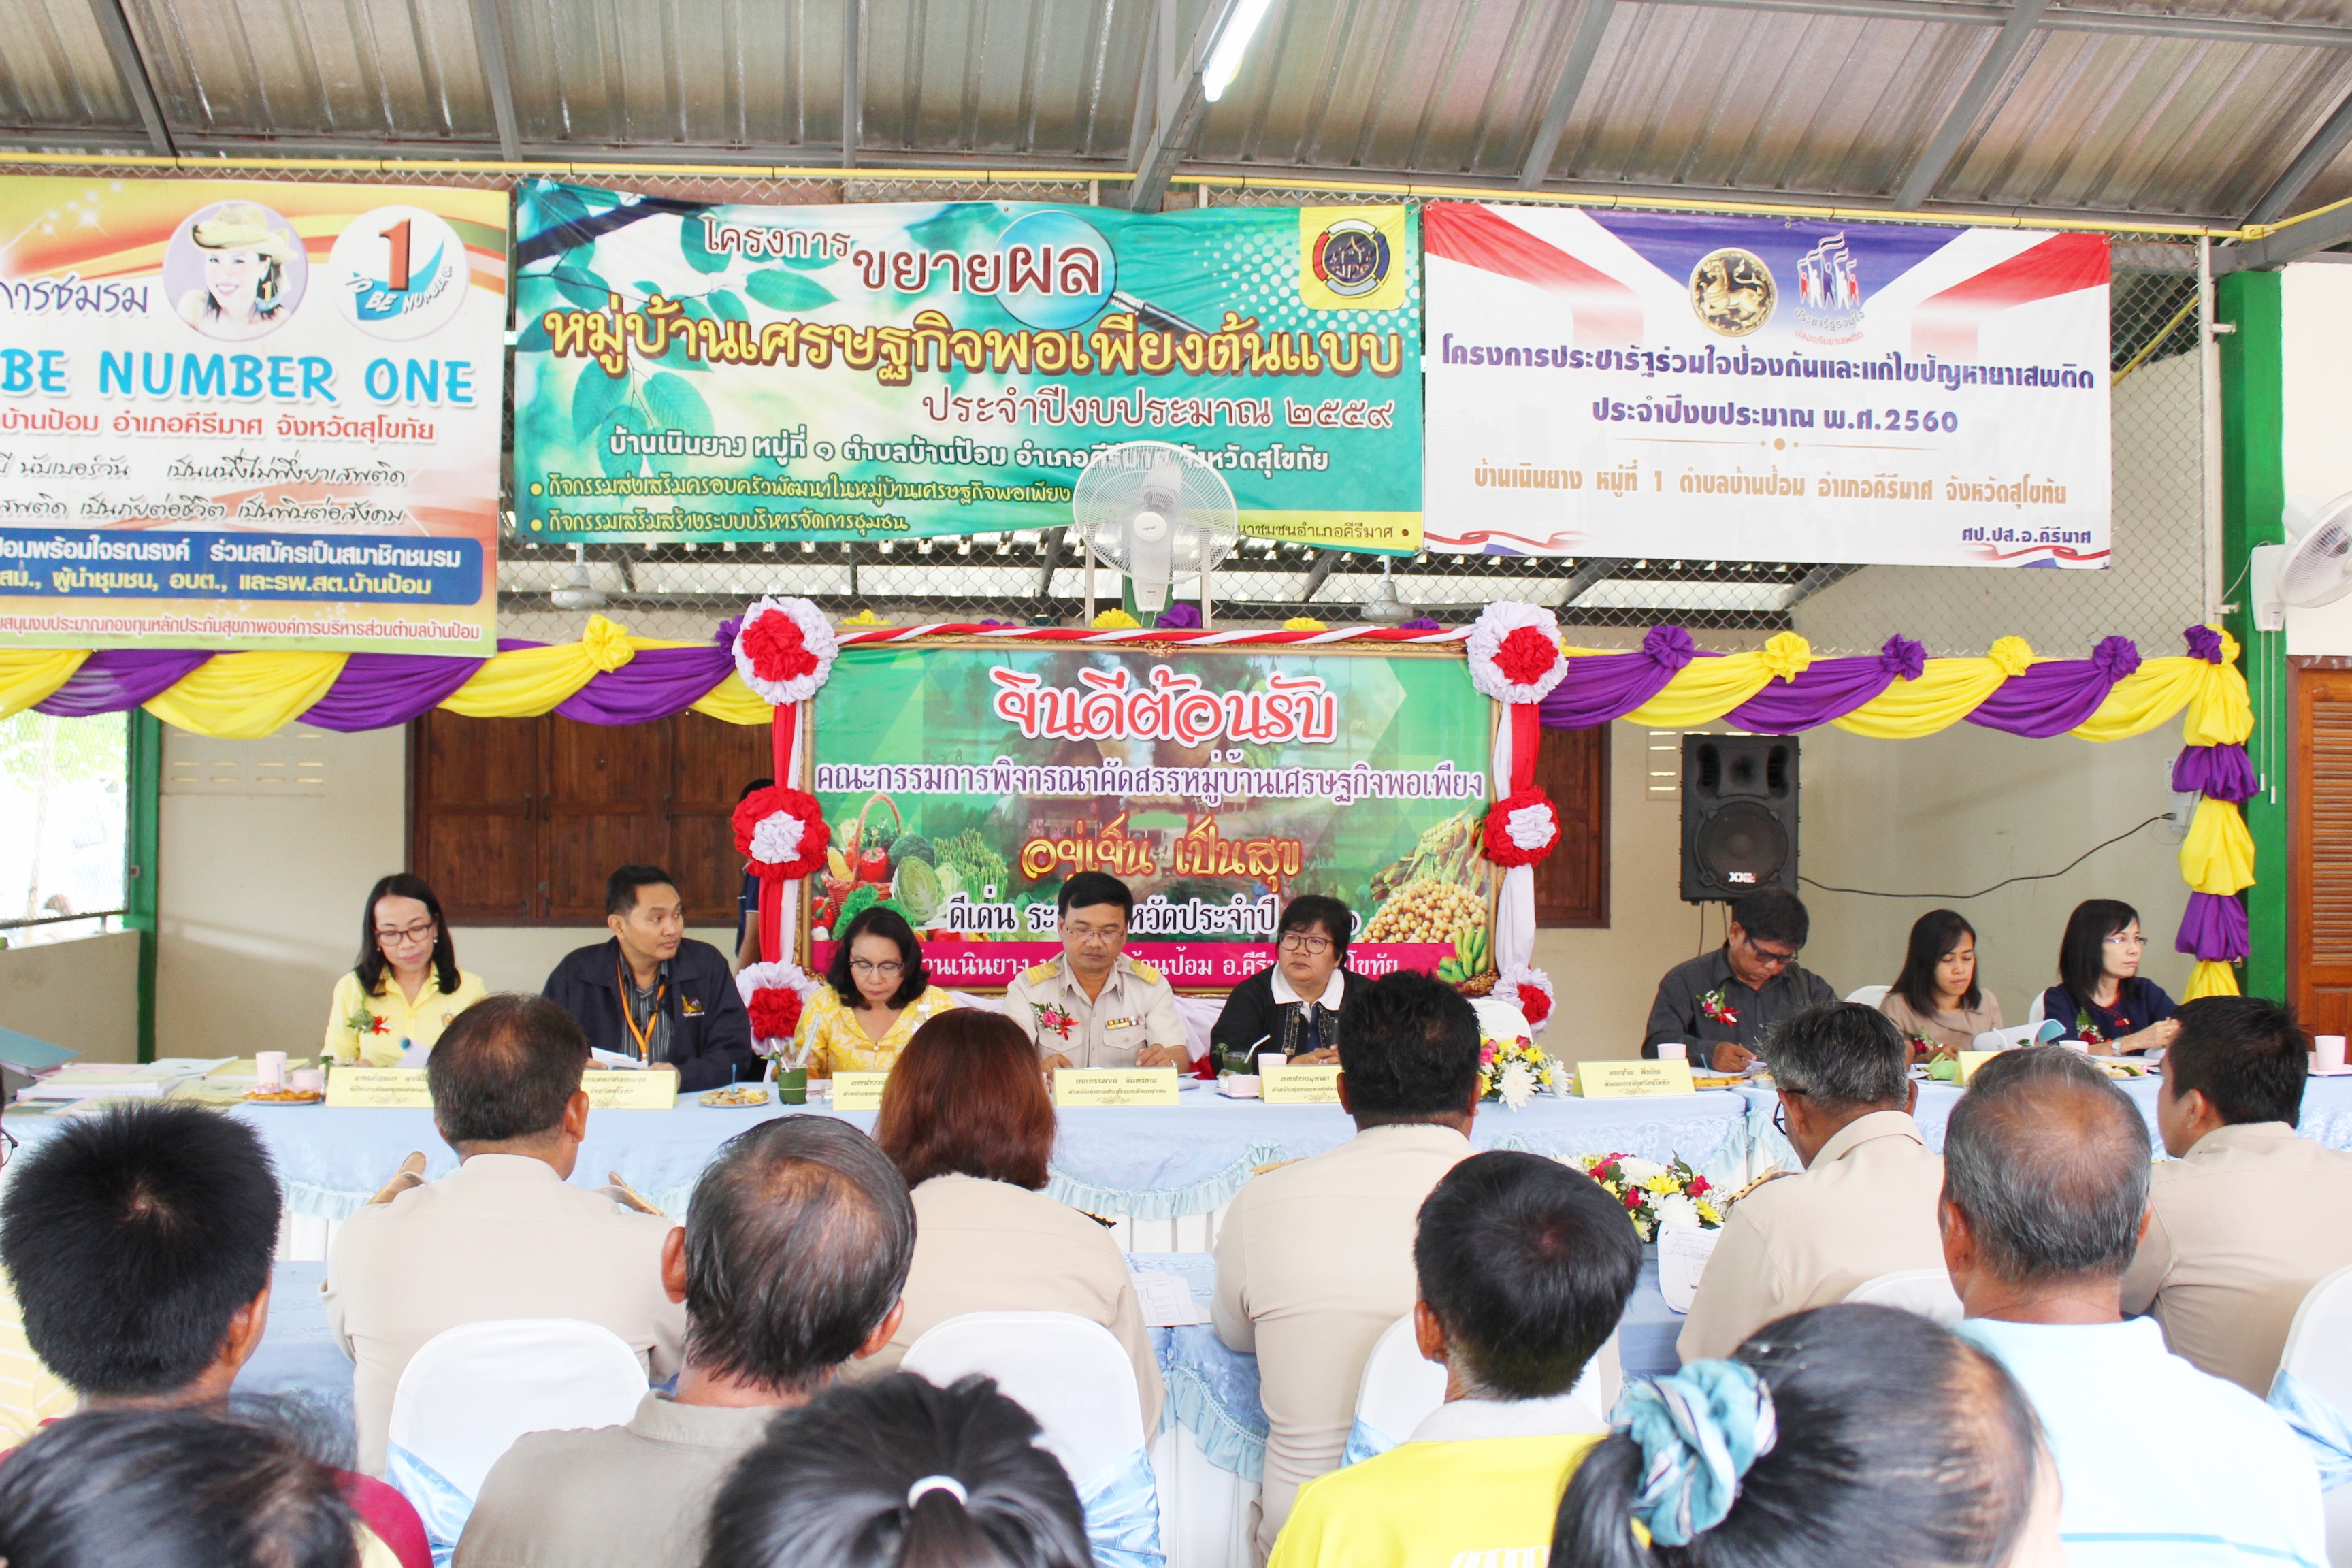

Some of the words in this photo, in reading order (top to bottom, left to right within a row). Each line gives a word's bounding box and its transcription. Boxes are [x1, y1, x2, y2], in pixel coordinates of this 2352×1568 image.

[703, 216, 850, 257] โครงการ
[853, 244, 1100, 293] ขยายผล
[365, 290, 398, 312] BE
[544, 294, 1402, 383] หมู่บ้านเศรษฐกิจพอเพียงต้นแบบ
[1, 348, 67, 393] BE
[100, 350, 336, 403] NUMBER
[365, 358, 474, 404] ONE
[1442, 333, 2094, 391] โครงการประชารัฐร่วมใจป้องกันและแก้ไขปัญหายาเสพติด
[114, 410, 263, 436] อำเภอคีรีมาศ
[277, 413, 434, 443] จังหวัดสุโขทัย
[922, 386, 1270, 427] ประจำปีงบประมาณ
[1286, 397, 1394, 428] ๒๕๕๙
[1592, 394, 1814, 427] ประจำปีงบประมาณ
[1824, 408, 1957, 433] พ.ศ.2560
[610, 426, 745, 457] บ้านเนินยาง
[753, 423, 807, 466] หมู่ที่
[815, 441, 835, 461] ๑
[842, 435, 1007, 466] ตำบลบ้านป้อม
[1474, 457, 1582, 490] บ้านเนินยาง
[1596, 459, 1637, 498] หมู่ที่
[1654, 470, 1663, 493] 1
[1680, 465, 1805, 497] ตำบลบ้านป้อม
[1818, 472, 1933, 500] อำเภอคีรีมาศ
[1946, 474, 2066, 509] จังหวัดสุโขทัย
[210, 539, 461, 568] ร่วมสมัครเป็นสมาชิกชมรม
[1962, 526, 2091, 544] ศป.ปส.อ.คีรีมาศ
[52, 566, 159, 593] ผู้นำชุมชน,
[170, 572, 227, 593] อบต.,
[239, 572, 431, 595] และรพ.สต.บ้านป้อม
[993, 669, 1333, 744] ยินดีต้อนรับ
[817, 751, 1483, 804] คณะกรรมการพิจารณาคัดสรรหมู่บ้านเศรษฐกิจพอเพียง
[1176, 815, 1300, 893] เป็นสุข
[949, 887, 1015, 930] ดีเด่น
